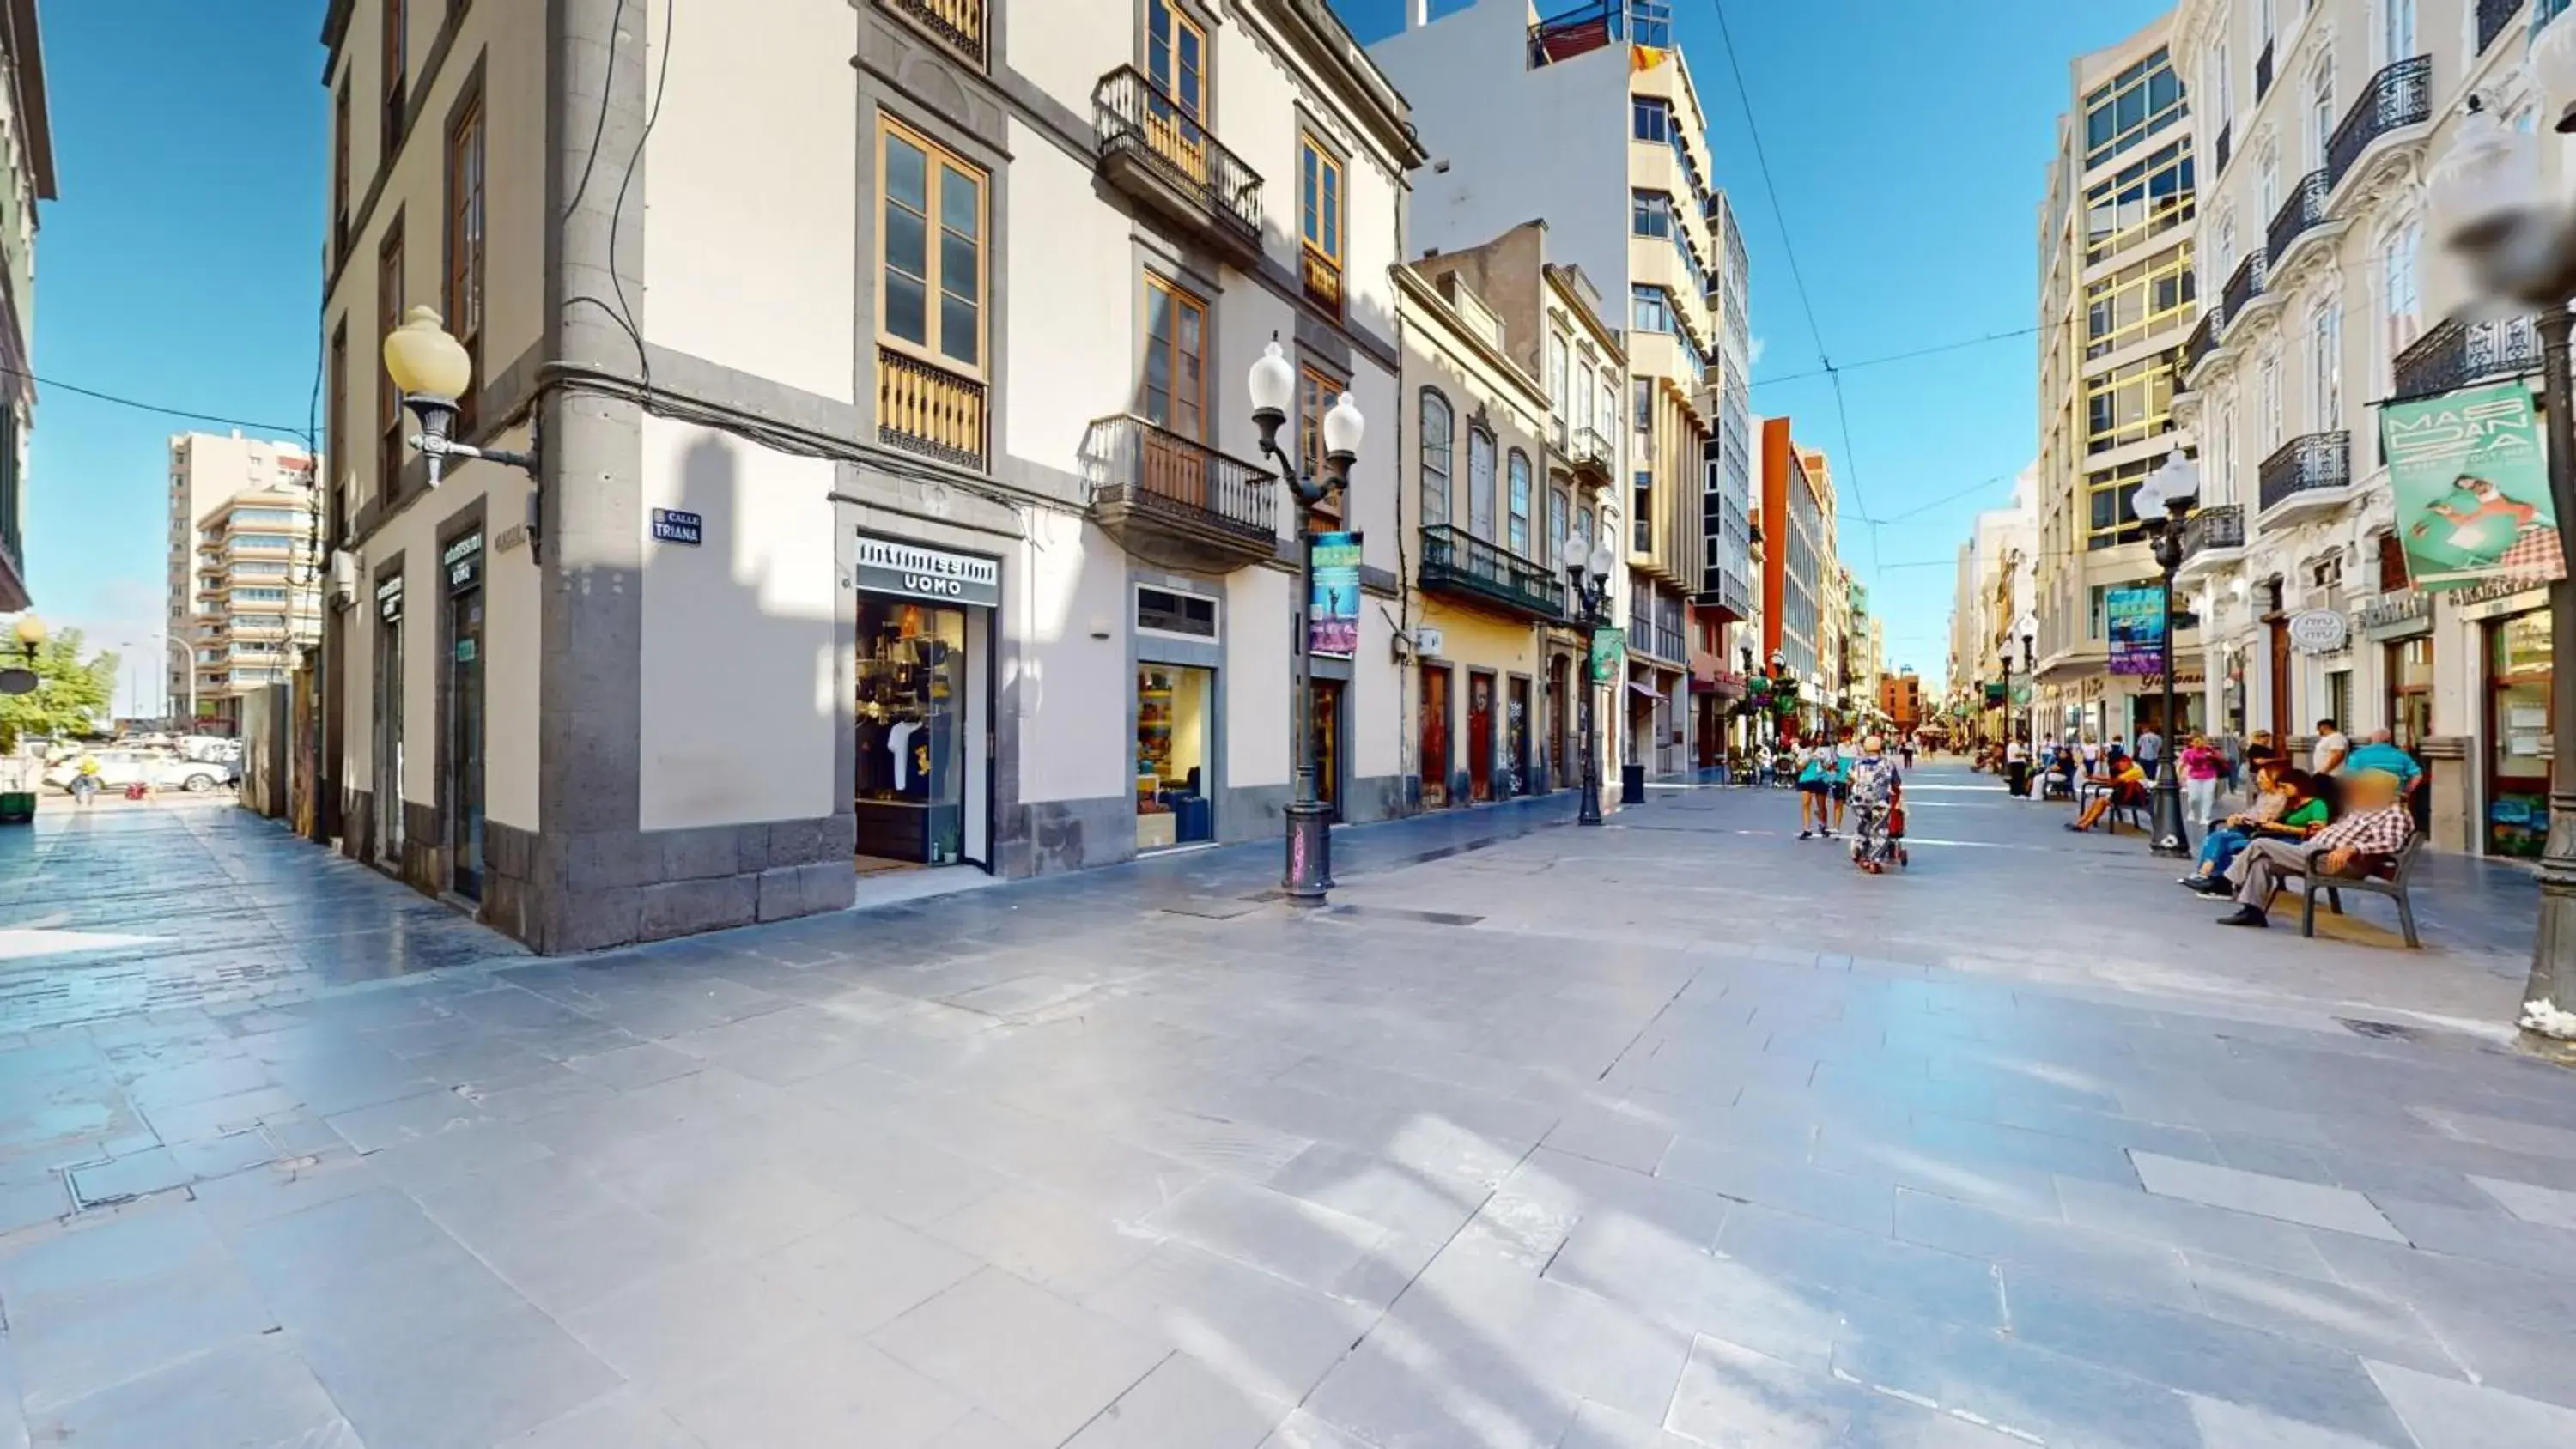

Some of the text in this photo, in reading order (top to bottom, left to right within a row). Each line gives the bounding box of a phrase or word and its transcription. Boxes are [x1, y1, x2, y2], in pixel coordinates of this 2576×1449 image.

[2388, 397, 2525, 433] MAS
[2391, 413, 2529, 449] DAN
[655, 523, 698, 542] TRIANA
[904, 573, 962, 596] UOMO
